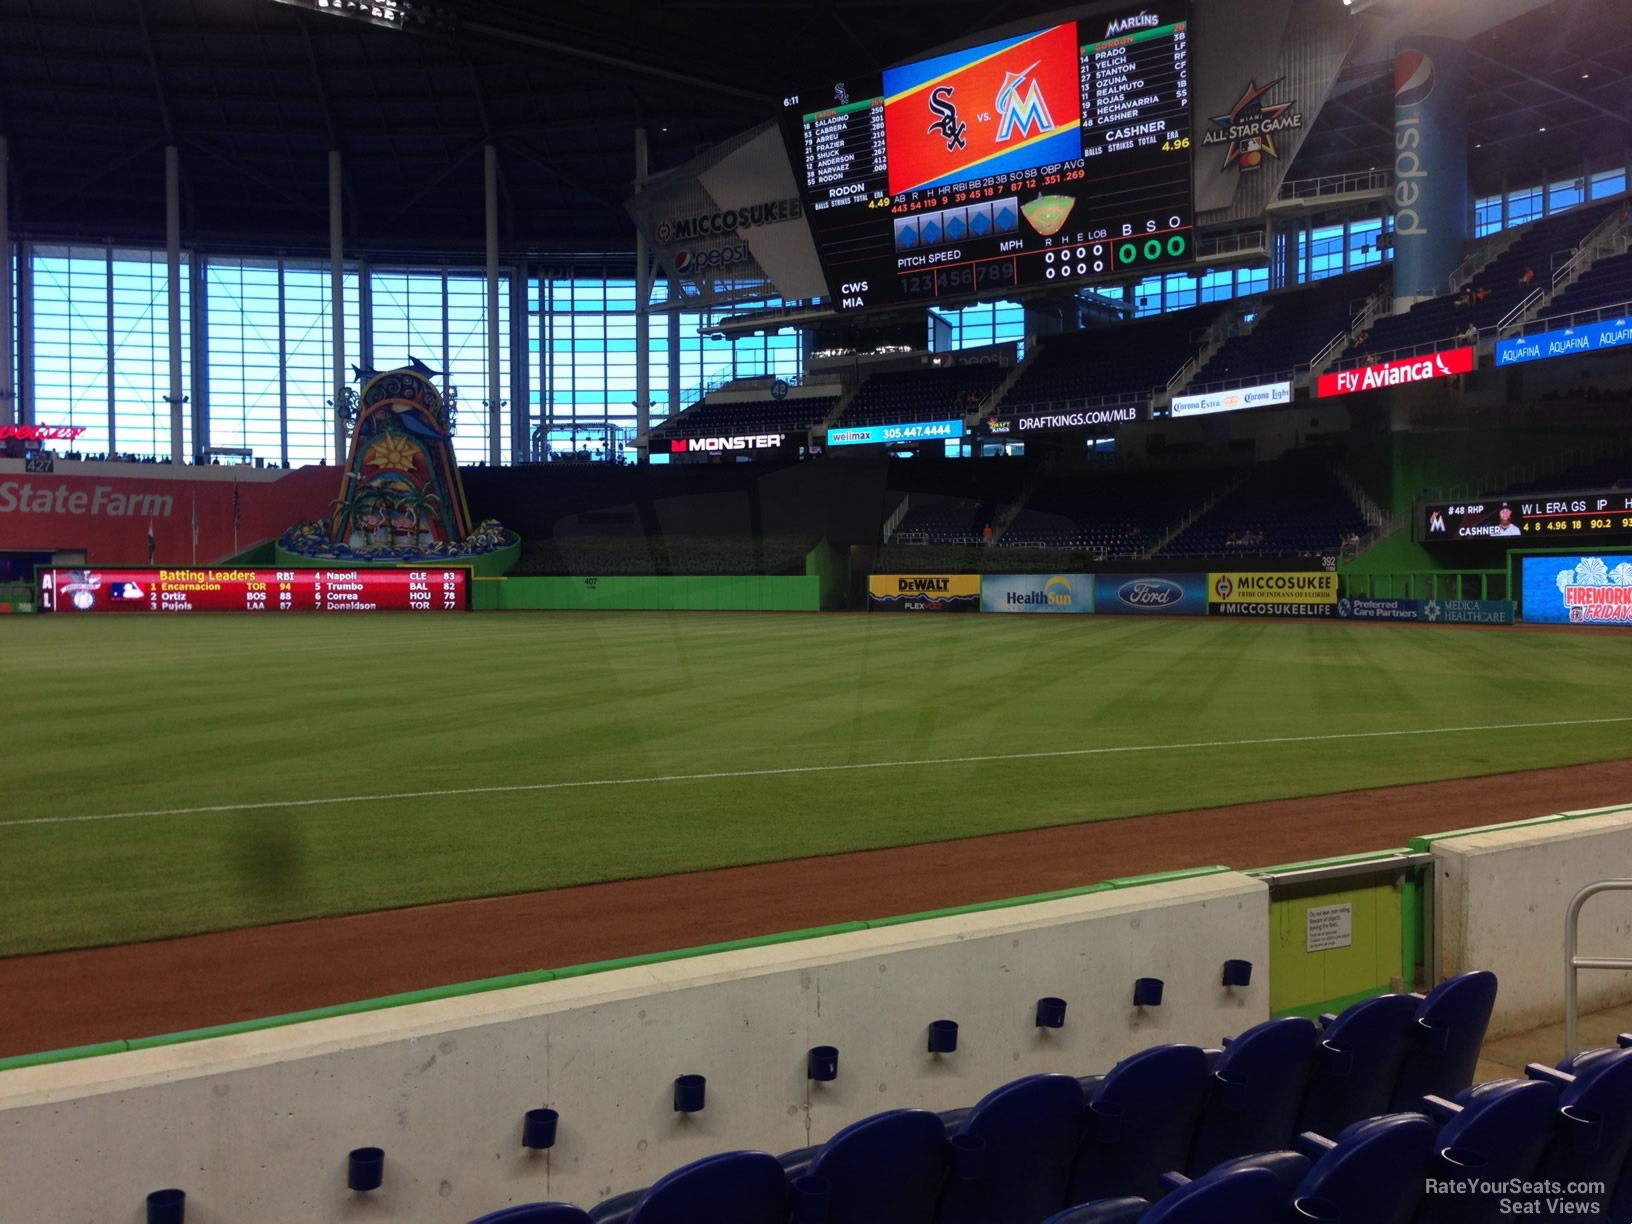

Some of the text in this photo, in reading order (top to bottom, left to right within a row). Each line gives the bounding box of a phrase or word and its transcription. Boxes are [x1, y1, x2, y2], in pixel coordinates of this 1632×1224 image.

[1105, 12, 1159, 39] MARLINS
[1095, 32, 1185, 60] PRADO 3B
[1096, 42, 1186, 69] YELICH LF
[1096, 51, 1186, 79] STANTON RF
[1096, 61, 1186, 88] OZUNA CF
[1096, 80, 1144, 97] REALMUTO
[1097, 80, 1187, 106] ROJAS 1B
[784, 96, 799, 107] 6:11
[1097, 89, 1187, 115] HECHAVARRIA SS
[815, 114, 849, 128] SALADINO
[976, 112, 991, 123] VS.
[1097, 110, 1138, 124] CASHNER
[1261, 115, 1301, 132] GAME
[815, 124, 847, 136] CABRERA
[1106, 120, 1165, 141] CASHNER
[816, 134, 839, 144] ABREU
[816, 140, 845, 152] FRAZIER
[1084, 130, 1179, 157] BALLS STRIKES TOTAL ERA
[1162, 138, 1190, 151] 4.96
[817, 150, 840, 160] SHUCK
[818, 154, 855, 168] ANDERSON
[818, 164, 850, 175] NARVAEZ
[1395, 116, 1427, 236] pepsi
[818, 172, 843, 183] RODON
[894, 159, 1084, 204] AB R H HR RBI BB 2B 3B SO SB OBP AVG
[829, 183, 865, 198] RODON
[891, 170, 1085, 214] 443 54 119 9 39 45 18 7 87 12 .351 .269
[868, 197, 890, 209] 4.49
[673, 200, 801, 240] MICCOSUKEE
[1122, 216, 1181, 236] B S O
[1000, 240, 1023, 252] MPH
[695, 242, 748, 272] pepsi
[898, 250, 961, 268] PITCH SPEED
[841, 281, 868, 294] CWS
[843, 297, 864, 309] MIA
[1549, 336, 1589, 355] AQUAFINA
[1502, 345, 1540, 363] AQUAFINA
[1337, 359, 1433, 392] Fly Avianca
[1244, 392, 1269, 403] Corona
[1174, 400, 1220, 412] Corona Extra
[1019, 408, 1136, 430] DRAFTKINGS.COM/MLB
[832, 425, 951, 442] wellmax 305.447.4444
[689, 434, 780, 451] MONSTER
[27, 460, 52, 472] 427
[0, 481, 173, 517] State Farm
[1448, 500, 1608, 515] #48 RHP W L ERA GS IP
[1459, 519, 1612, 536] CASHNER 4 8 4.96 18 90.2
[1322, 557, 1335, 566] 392
[160, 570, 204, 582] Batting
[209, 570, 256, 580] Leaders
[276, 572, 294, 581] RBI
[327, 572, 357, 582] Napoli
[1238, 576, 1331, 589] MICCOSUKEE
[1007, 592, 1072, 605] HealthSun
[1130, 582, 1169, 604] Ford
[162, 602, 455, 611] Pujols LAA 87 Donaldson TOR 77
[1220, 604, 1330, 615] #MICCOSUKEELIFE
[1354, 601, 1397, 609] Preferred
[1444, 601, 1480, 610] MEDICA
[1376, 609, 1417, 618] Partners
[1445, 612, 1505, 622] HEALTHCARE
